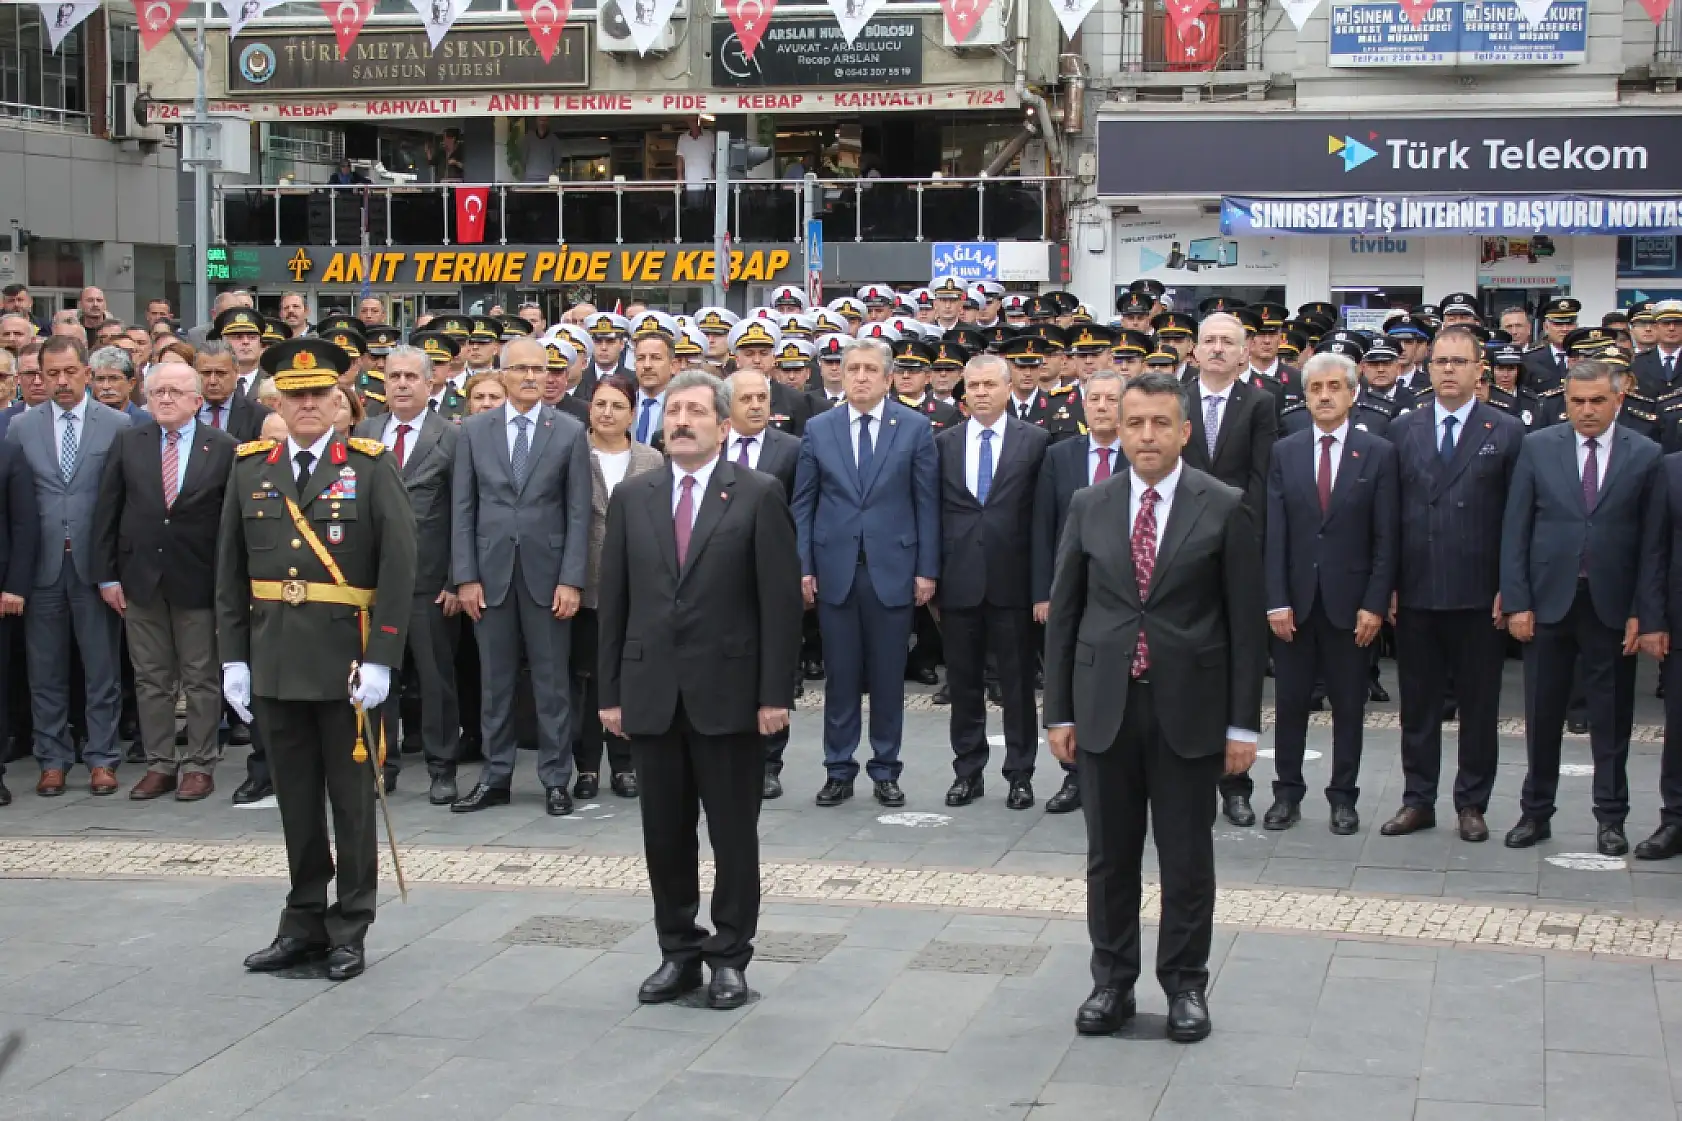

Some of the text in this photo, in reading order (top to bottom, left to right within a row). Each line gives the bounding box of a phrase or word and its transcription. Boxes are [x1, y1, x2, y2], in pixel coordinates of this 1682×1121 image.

[1353, 8, 1393, 24] SİNEM
[768, 27, 815, 40] ARSLAN
[865, 24, 914, 36] BÜROSU
[356, 42, 433, 60] METAL
[776, 43, 821, 53] AVUKAT
[831, 40, 901, 52] ARABULUCU
[797, 53, 880, 65] Recep ARSLAN
[352, 59, 500, 80] SAMSUN ŞUBESİ
[278, 103, 338, 117] KEBAP
[367, 99, 457, 114] KAHVALTI
[487, 94, 541, 111] ANIT
[552, 94, 632, 110] TERME
[663, 92, 707, 110] PİDE
[738, 94, 803, 109] KEBAP
[834, 92, 934, 107] KAHVALTI
[966, 89, 1006, 105] 7/24
[1386, 139, 1648, 171] Türk Telekom
[1250, 202, 1338, 228] SINIRSIZ
[1343, 197, 1396, 232] EV-İŞ
[1401, 198, 1498, 228] İNTERNET
[1503, 200, 1603, 233] BAŞVURU
[1350, 234, 1407, 254] tivibu
[321, 244, 790, 282] ANIT TERME PİDE VE KEBAP
[934, 244, 997, 272] SAĞLAM
